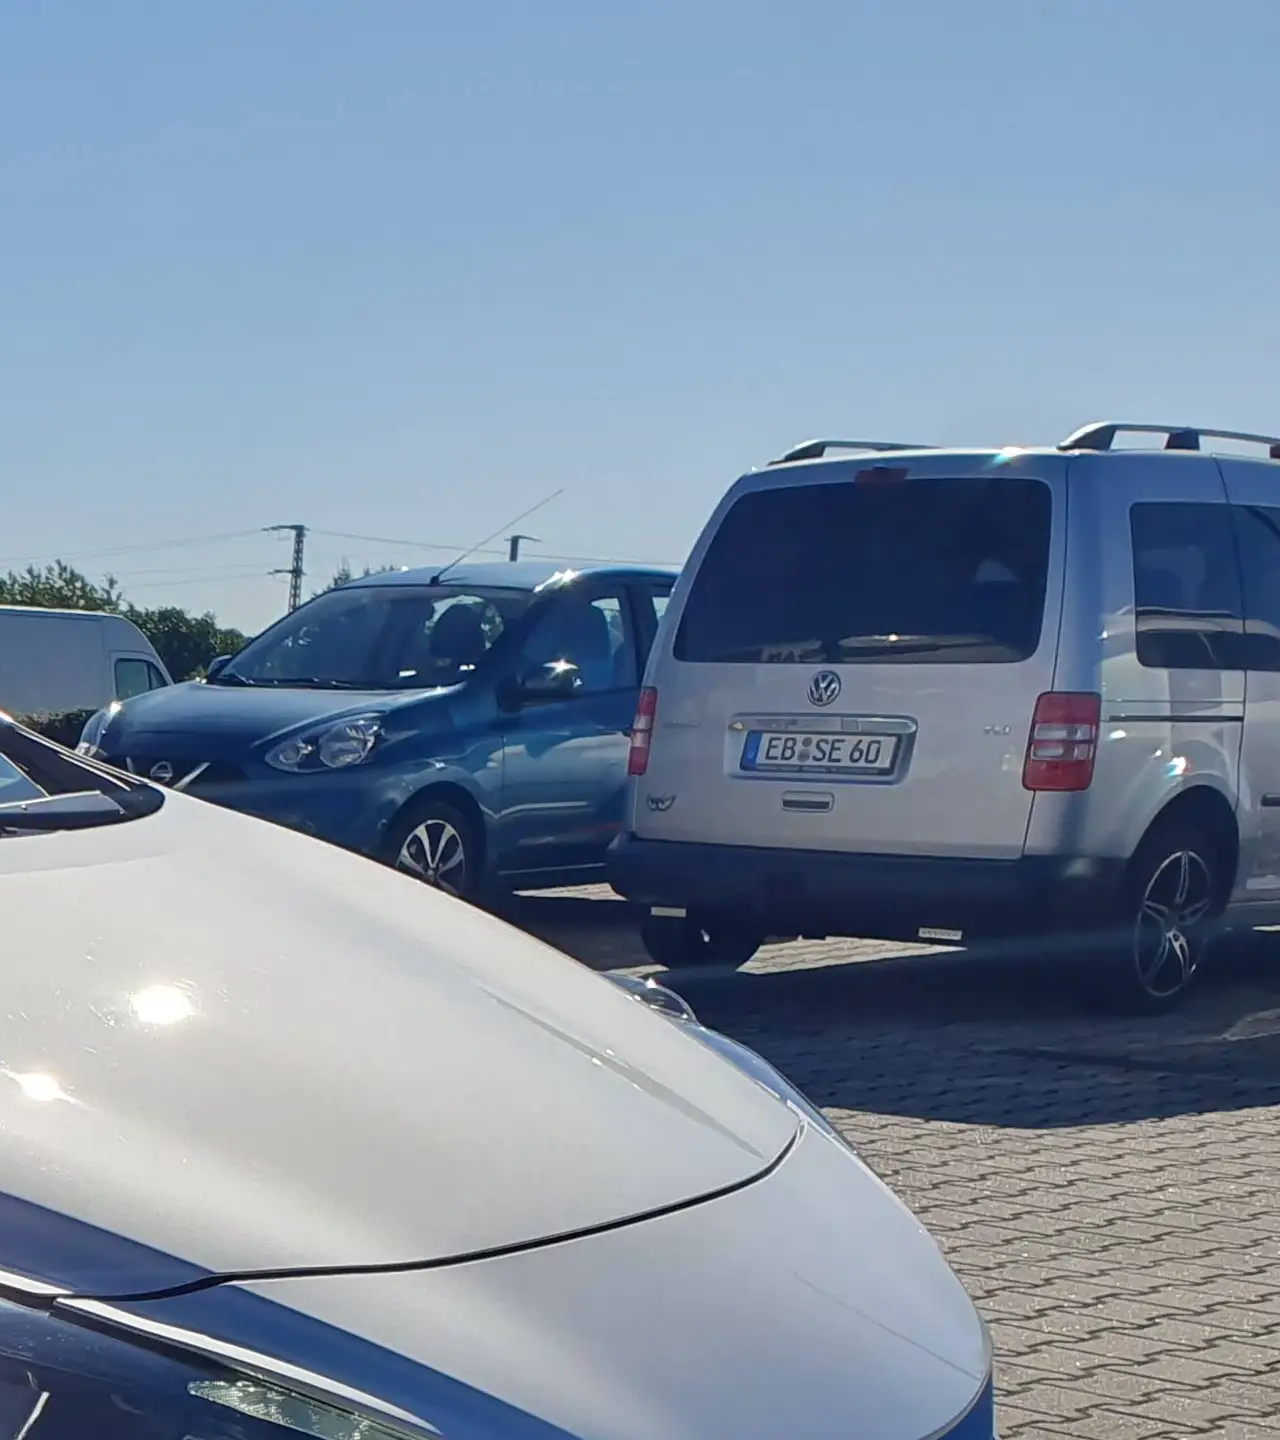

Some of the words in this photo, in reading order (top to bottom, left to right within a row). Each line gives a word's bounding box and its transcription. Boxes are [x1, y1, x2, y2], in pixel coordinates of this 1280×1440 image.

[765, 736, 797, 762] EB
[812, 738, 845, 763] SE
[848, 739, 882, 764] 60
